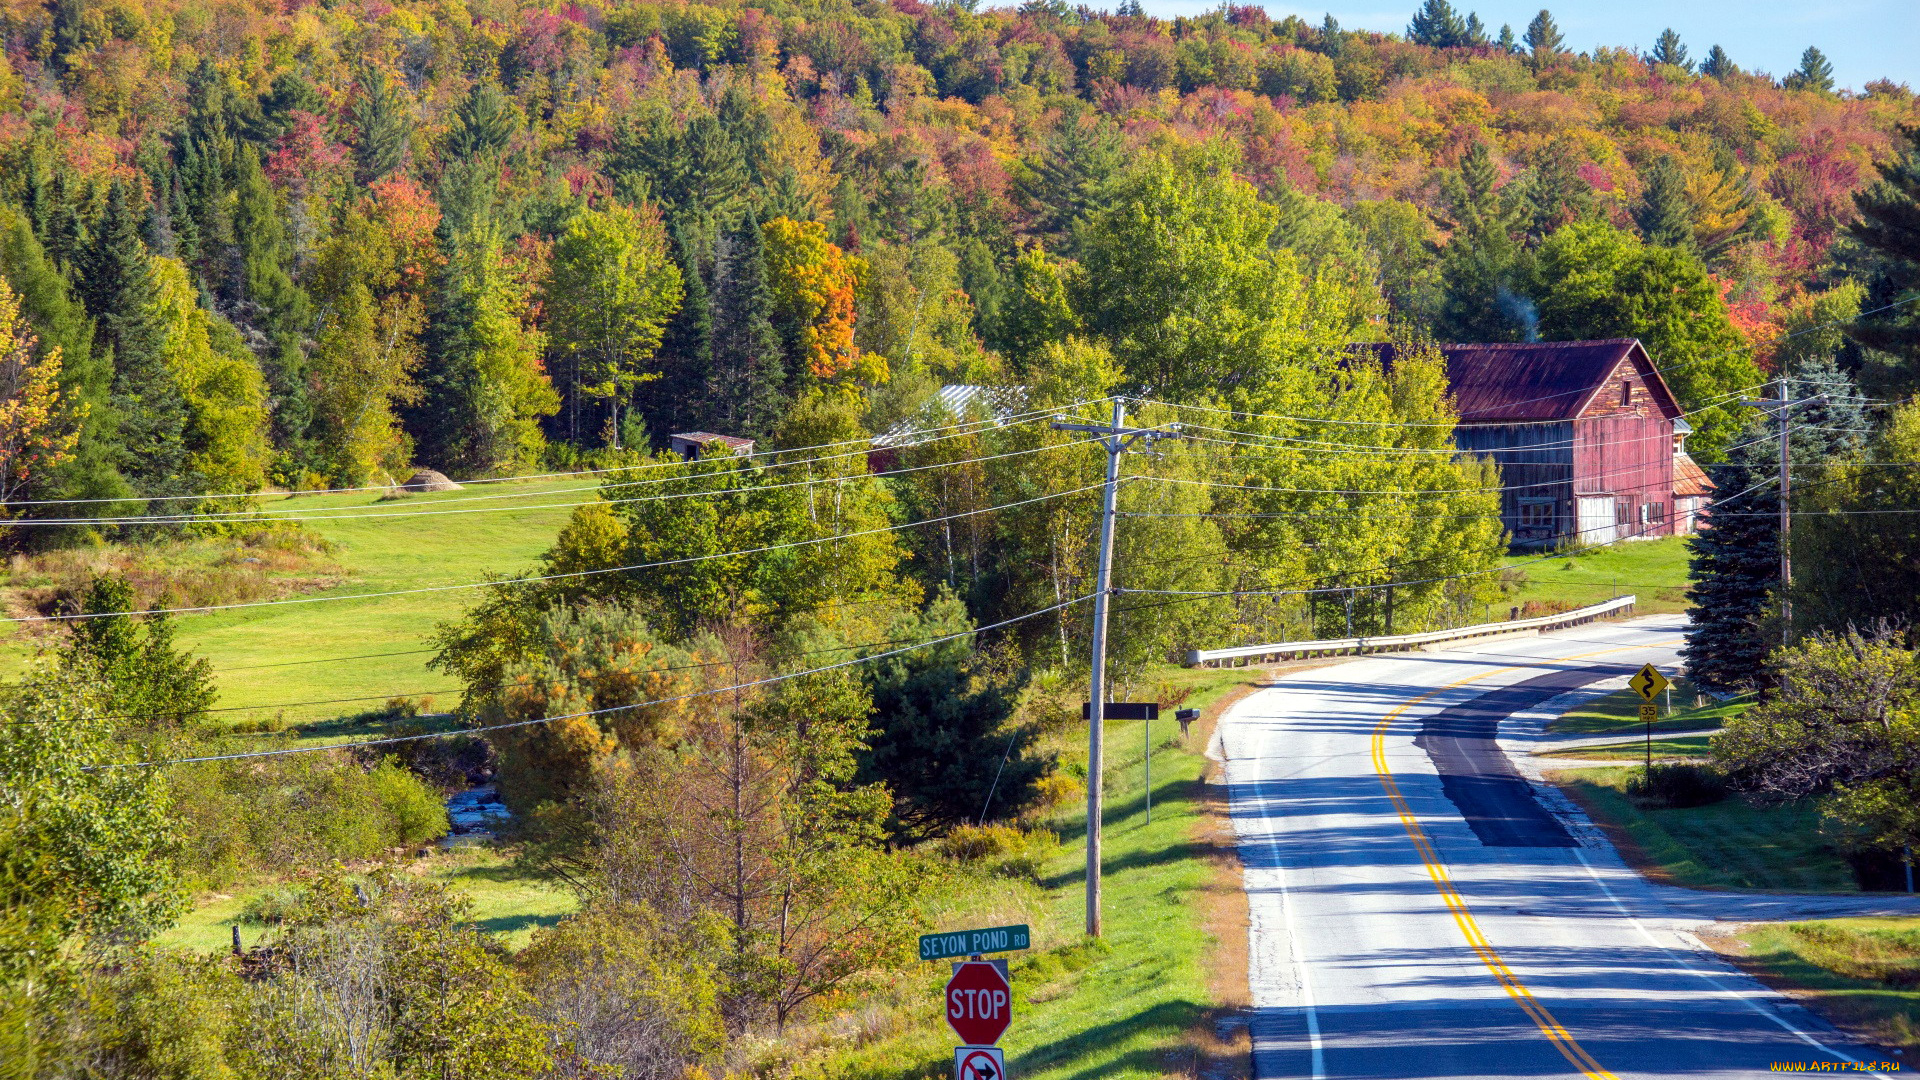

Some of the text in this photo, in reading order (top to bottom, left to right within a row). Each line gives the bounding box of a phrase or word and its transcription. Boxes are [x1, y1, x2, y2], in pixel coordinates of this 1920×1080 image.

[1642, 706, 1656, 716] 35
[922, 930, 1026, 957] SEYON POND RD
[950, 988, 1006, 1020] STOP
